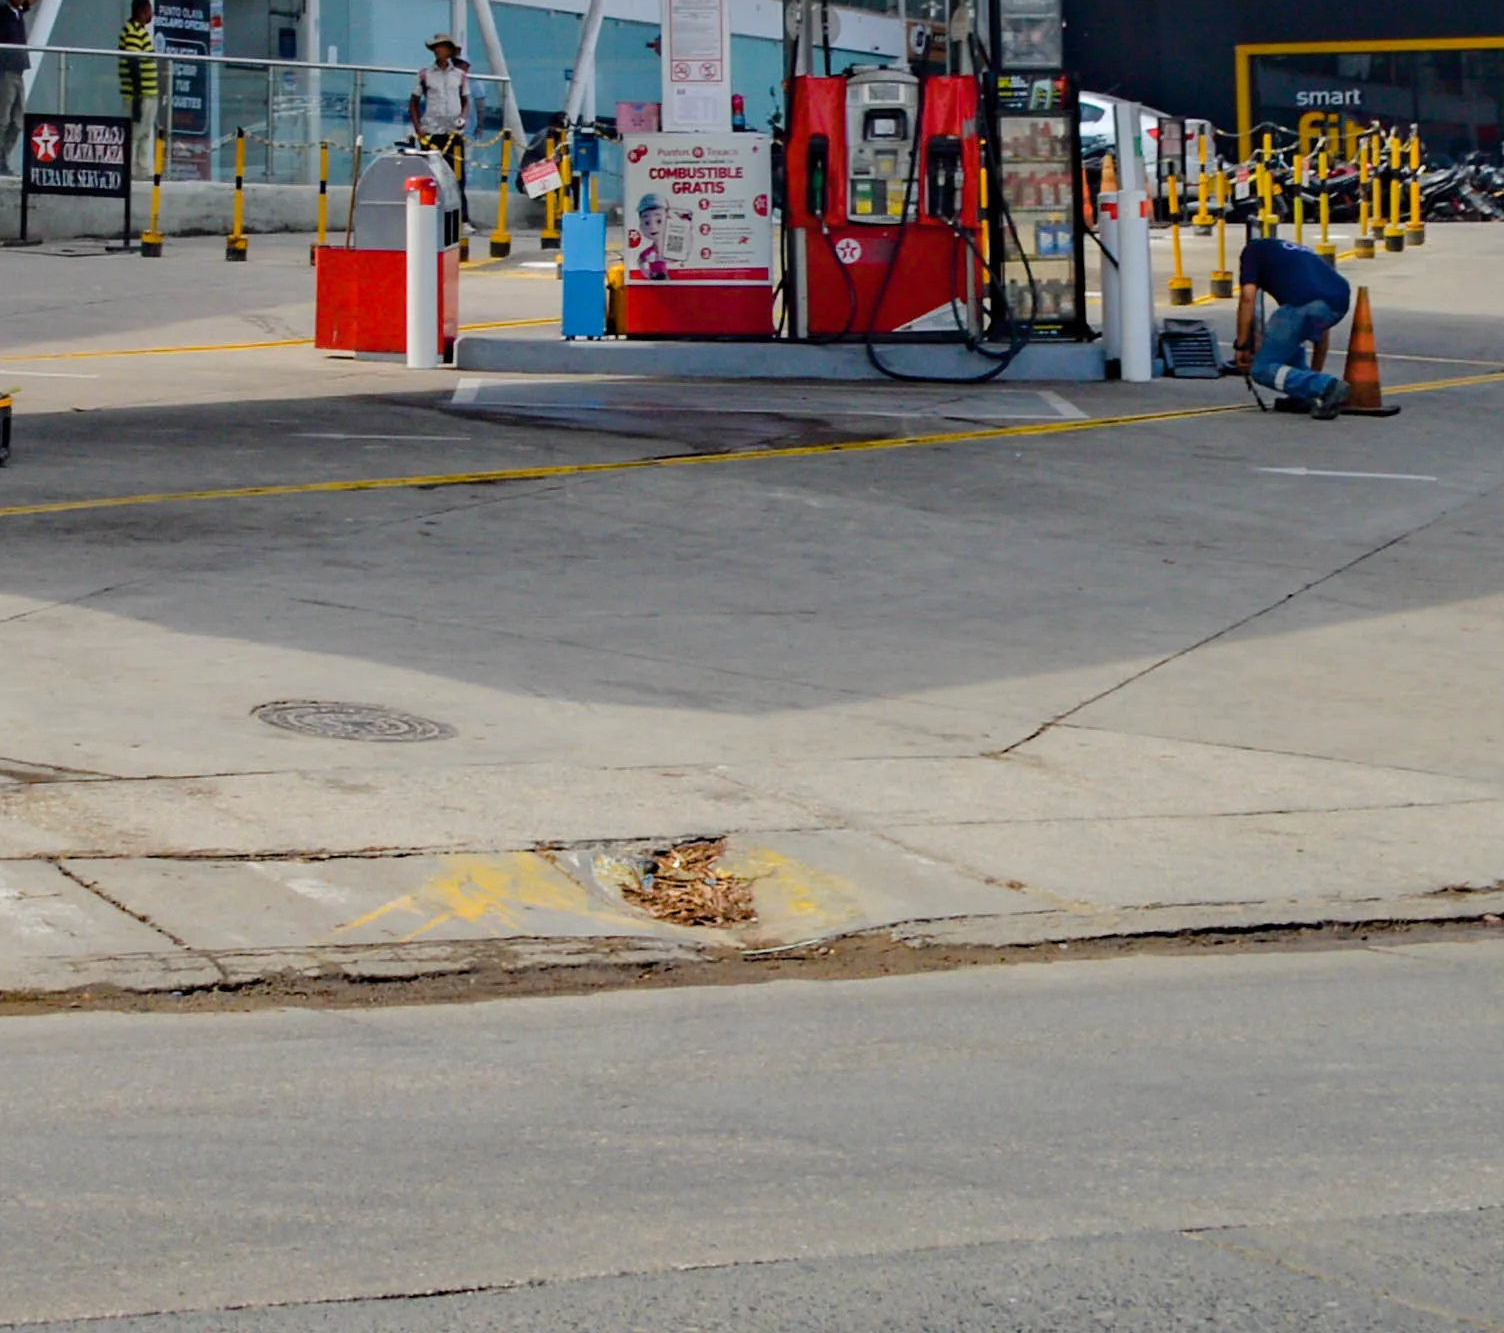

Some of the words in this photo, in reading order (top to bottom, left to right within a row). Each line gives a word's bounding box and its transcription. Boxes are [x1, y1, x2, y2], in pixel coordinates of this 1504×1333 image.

[1295, 89, 1362, 106] smart
[648, 167, 744, 180] COMBUSTIBLE
[671, 181, 726, 195] GRATIS
